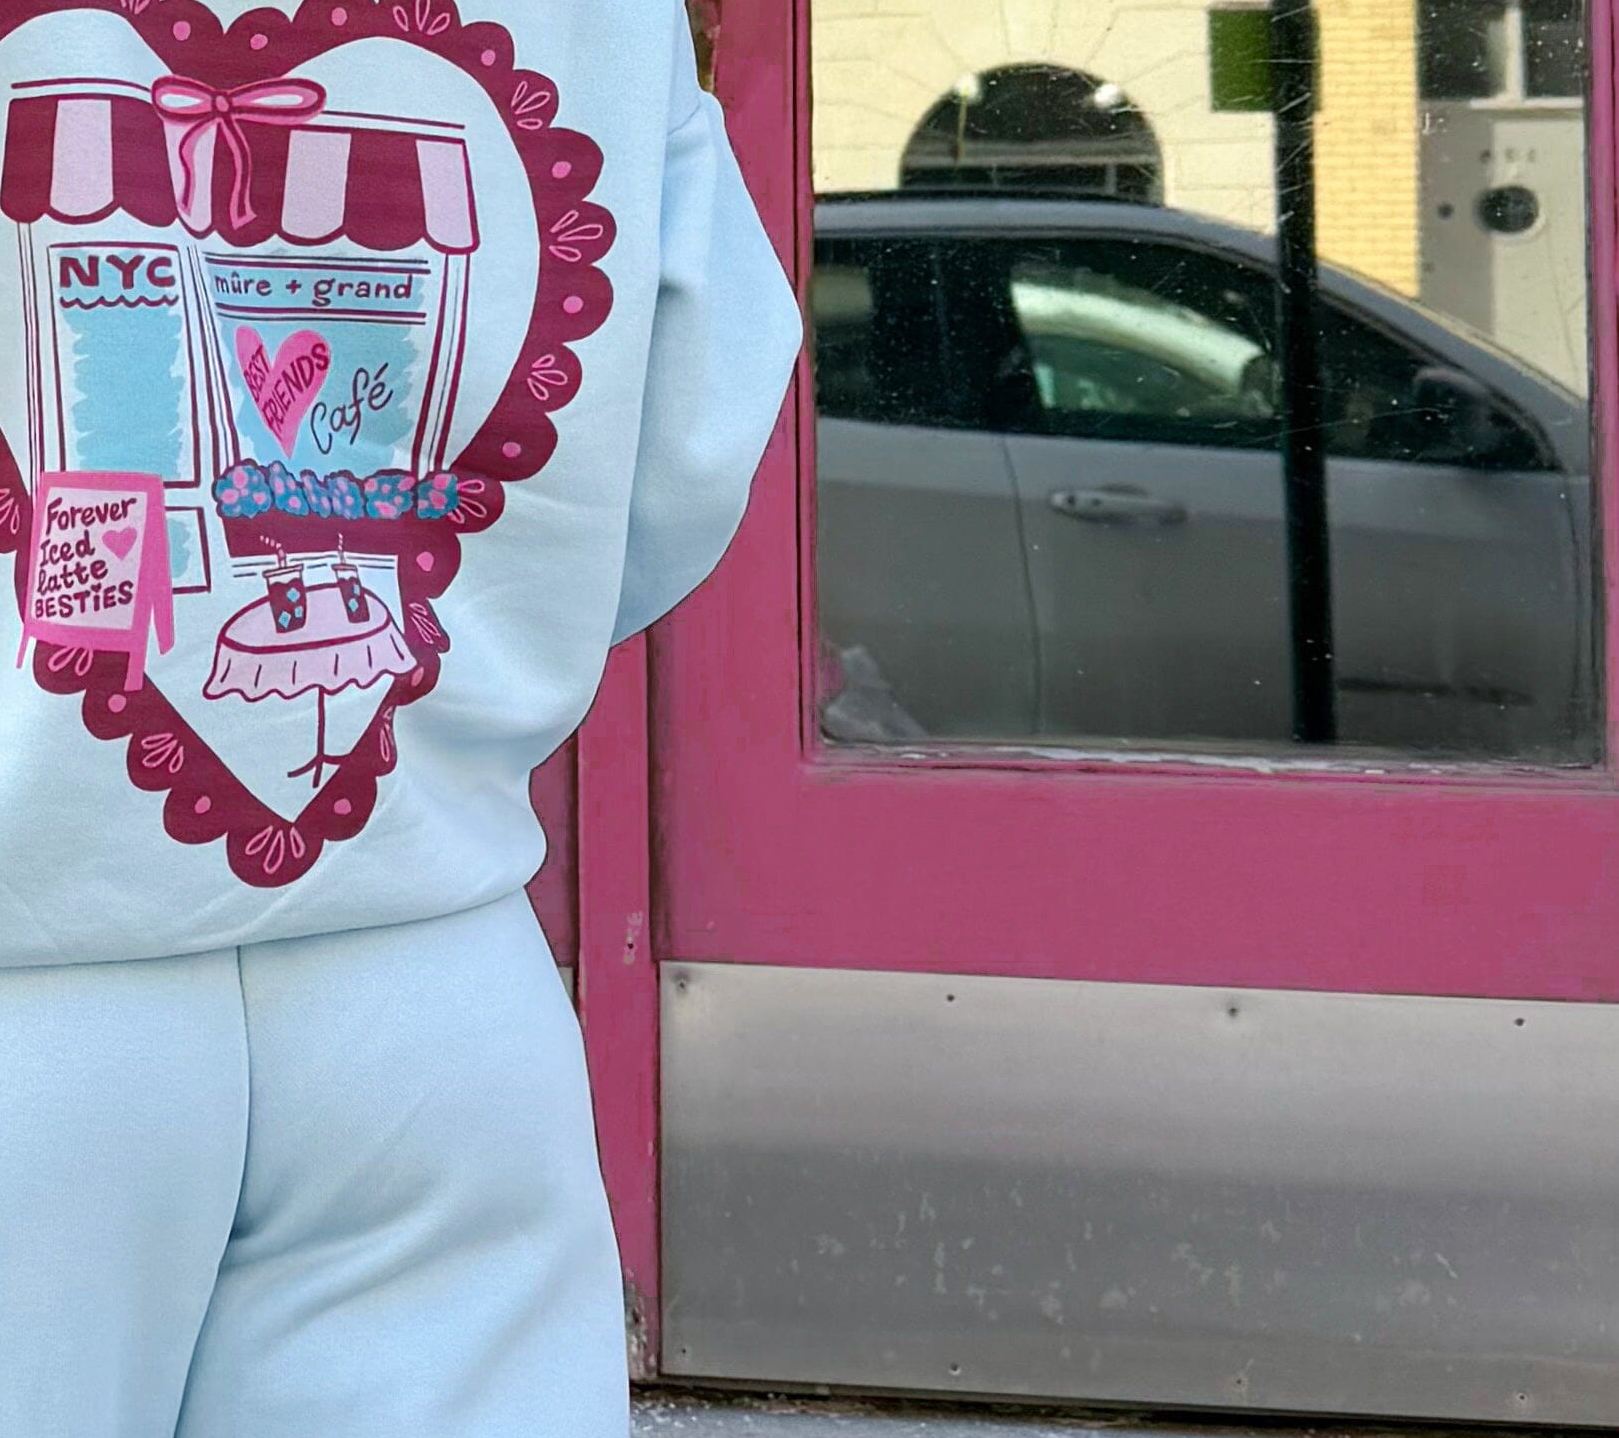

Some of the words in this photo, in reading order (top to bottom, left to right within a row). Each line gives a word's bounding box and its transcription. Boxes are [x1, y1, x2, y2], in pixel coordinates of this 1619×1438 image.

[59, 254, 179, 290] NYC
[214, 271, 273, 297] mûre
[311, 274, 413, 307] grand
[243, 344, 271, 403] BEST
[261, 342, 330, 431] FRIENDS
[310, 362, 394, 456] Café
[45, 496, 138, 537] Forever
[39, 528, 96, 568] Iced
[37, 559, 109, 596] latte
